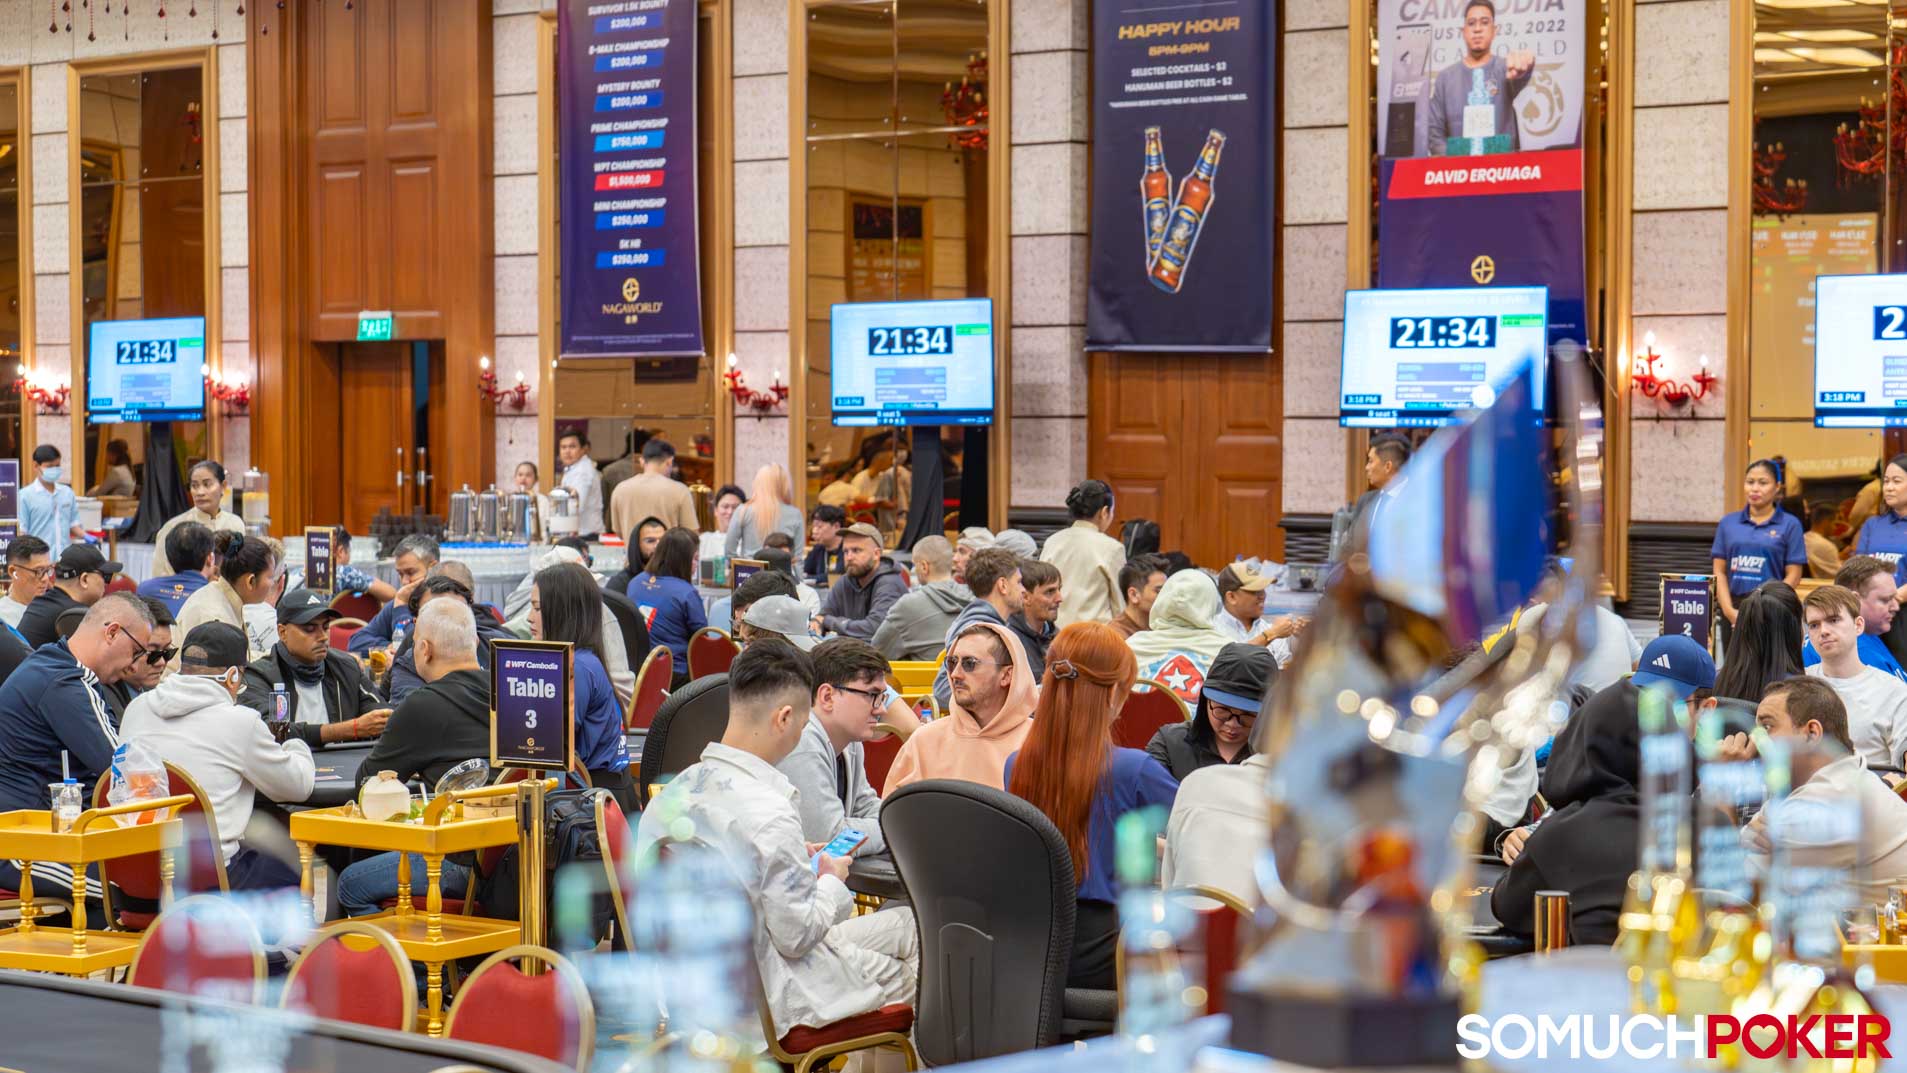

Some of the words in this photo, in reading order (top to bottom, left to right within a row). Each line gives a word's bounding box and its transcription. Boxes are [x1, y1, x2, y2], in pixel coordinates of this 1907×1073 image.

[1118, 21, 1183, 39] HAPPY
[1185, 16, 1241, 34] HOUR
[1525, 19, 1565, 34] 2022
[614, 38, 670, 52] CHAMPIONSHIP
[1131, 64, 1167, 77] SELECTED
[1167, 62, 1210, 75] COCKTAILS
[597, 81, 631, 94] MYSTERY
[630, 78, 662, 91] BOUNTY
[1124, 79, 1165, 92] HANUMAN
[1165, 79, 1183, 90] BEER
[1184, 77, 1216, 88] BOTTLES
[590, 122, 614, 133] PRIME
[613, 117, 669, 132] CHAMPIONSHIP
[594, 161, 610, 173] WPT
[611, 157, 667, 171] CHAMPIONSHIP
[1424, 169, 1468, 185] DAVID
[1469, 165, 1541, 182] ERQUIAGA
[593, 200, 611, 212] MINI
[611, 197, 667, 211] CHAMPIONSHIP
[1396, 317, 1490, 347] 21:34
[873, 327, 948, 354] 21:34
[119, 340, 173, 364] 21:34
[1823, 393, 1844, 402] 3:18
[1845, 393, 1861, 402] PM
[311, 545, 329, 557] Table
[316, 562, 325, 574] 14
[1738, 555, 1766, 568] WPT
[1670, 600, 1705, 615] Table
[1683, 622, 1692, 636] 2
[511, 660, 527, 668] WPT
[526, 661, 558, 670] Cambodia
[507, 677, 556, 699] Table
[525, 709, 537, 729] 3
